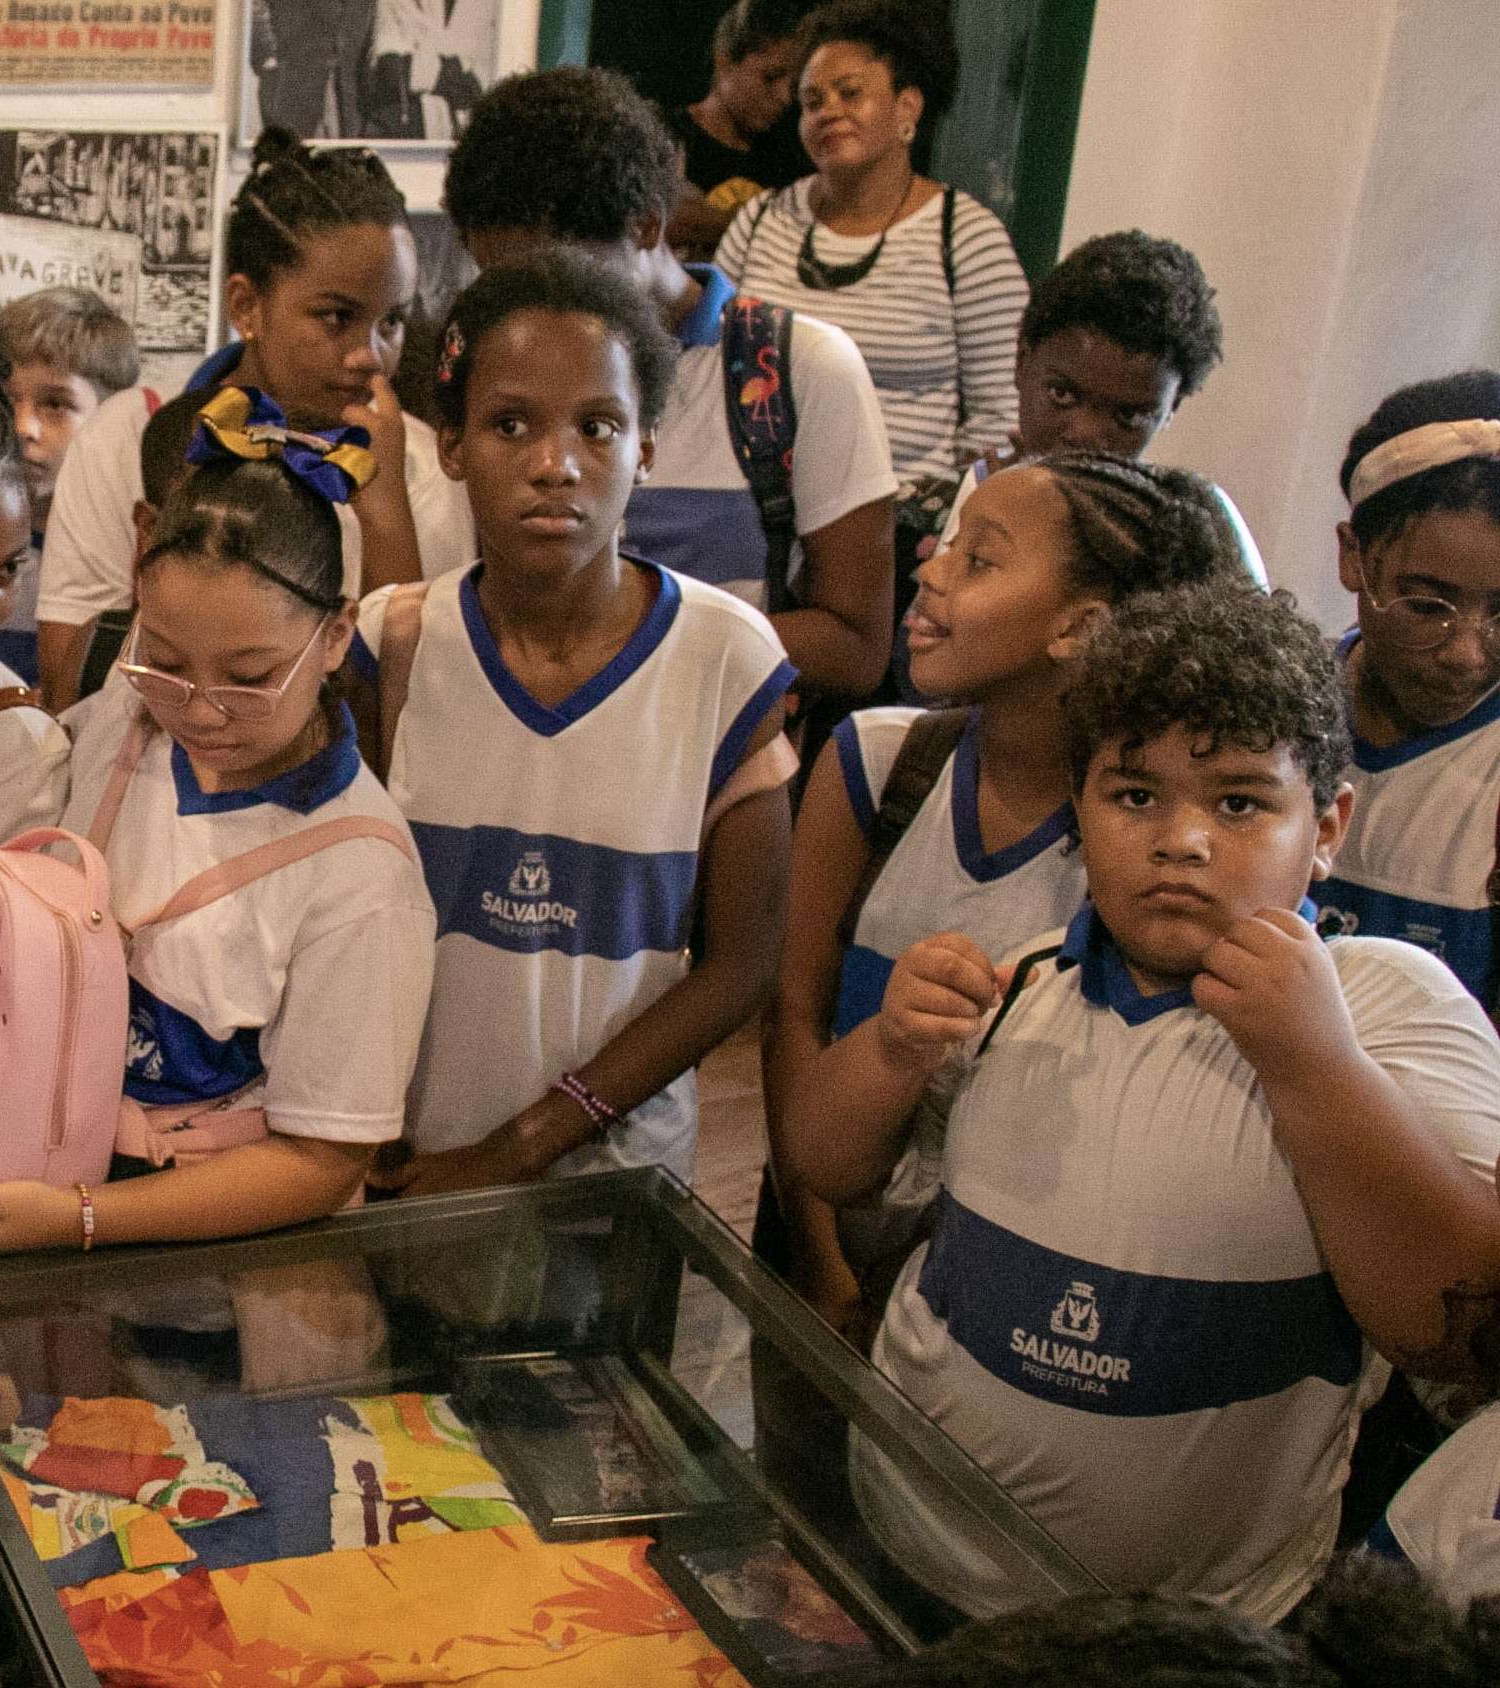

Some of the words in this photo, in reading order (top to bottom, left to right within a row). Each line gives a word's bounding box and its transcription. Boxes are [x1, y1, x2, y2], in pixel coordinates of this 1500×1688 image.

[482, 891, 578, 928] SALVADOR
[1010, 1327, 1131, 1381] SALVADOR
[1020, 1360, 1109, 1396] PREFEITURA
